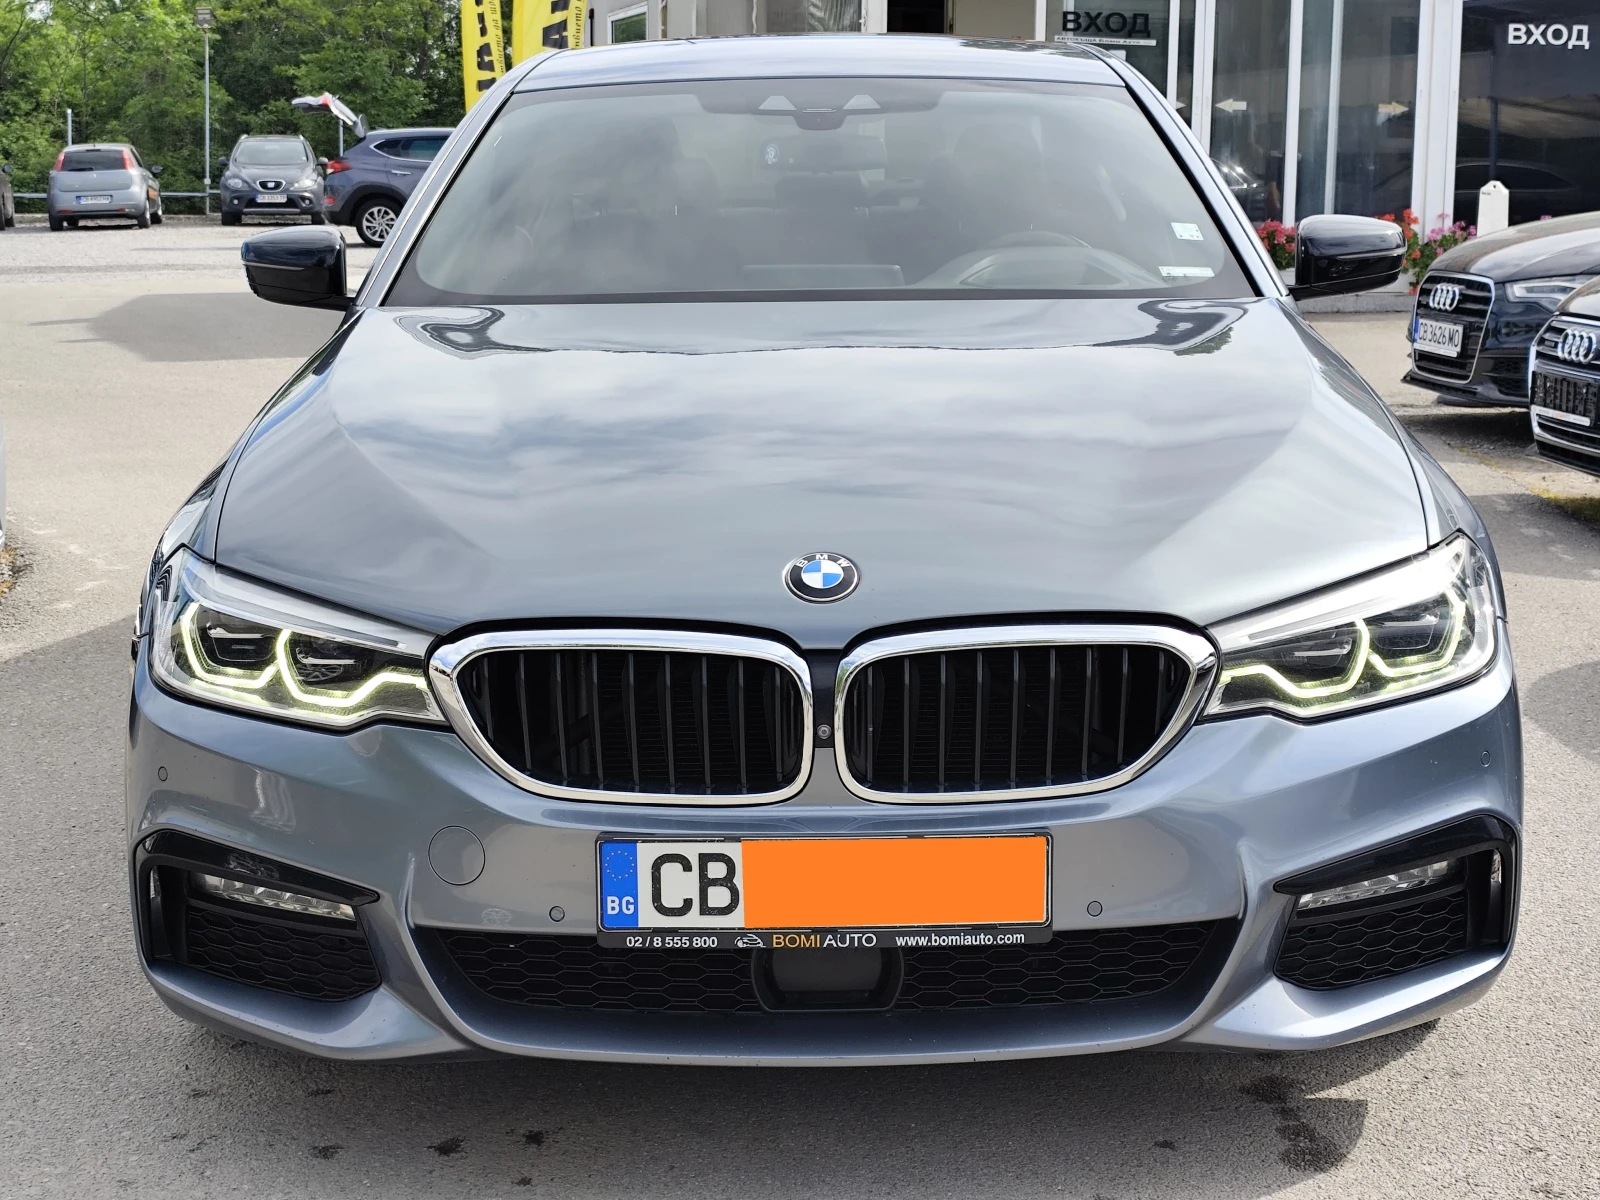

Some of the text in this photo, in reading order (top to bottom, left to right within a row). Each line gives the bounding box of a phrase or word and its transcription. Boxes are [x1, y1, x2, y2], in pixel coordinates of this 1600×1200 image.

[1062, 11, 1151, 38] ВХОД
[1507, 23, 1590, 50] ВХОД
[1419, 322, 1460, 348] CB 3626 MO
[795, 553, 853, 568] BMW
[651, 853, 740, 917] CB
[606, 896, 635, 915] BG
[626, 936, 643, 948] 02
[652, 936, 662, 948] 8
[665, 936, 690, 948] 555
[694, 936, 718, 948] 800
[772, 934, 820, 948] BOMI
[823, 933, 877, 948] AUTO
[895, 933, 1025, 947] www.bomiauto.com
